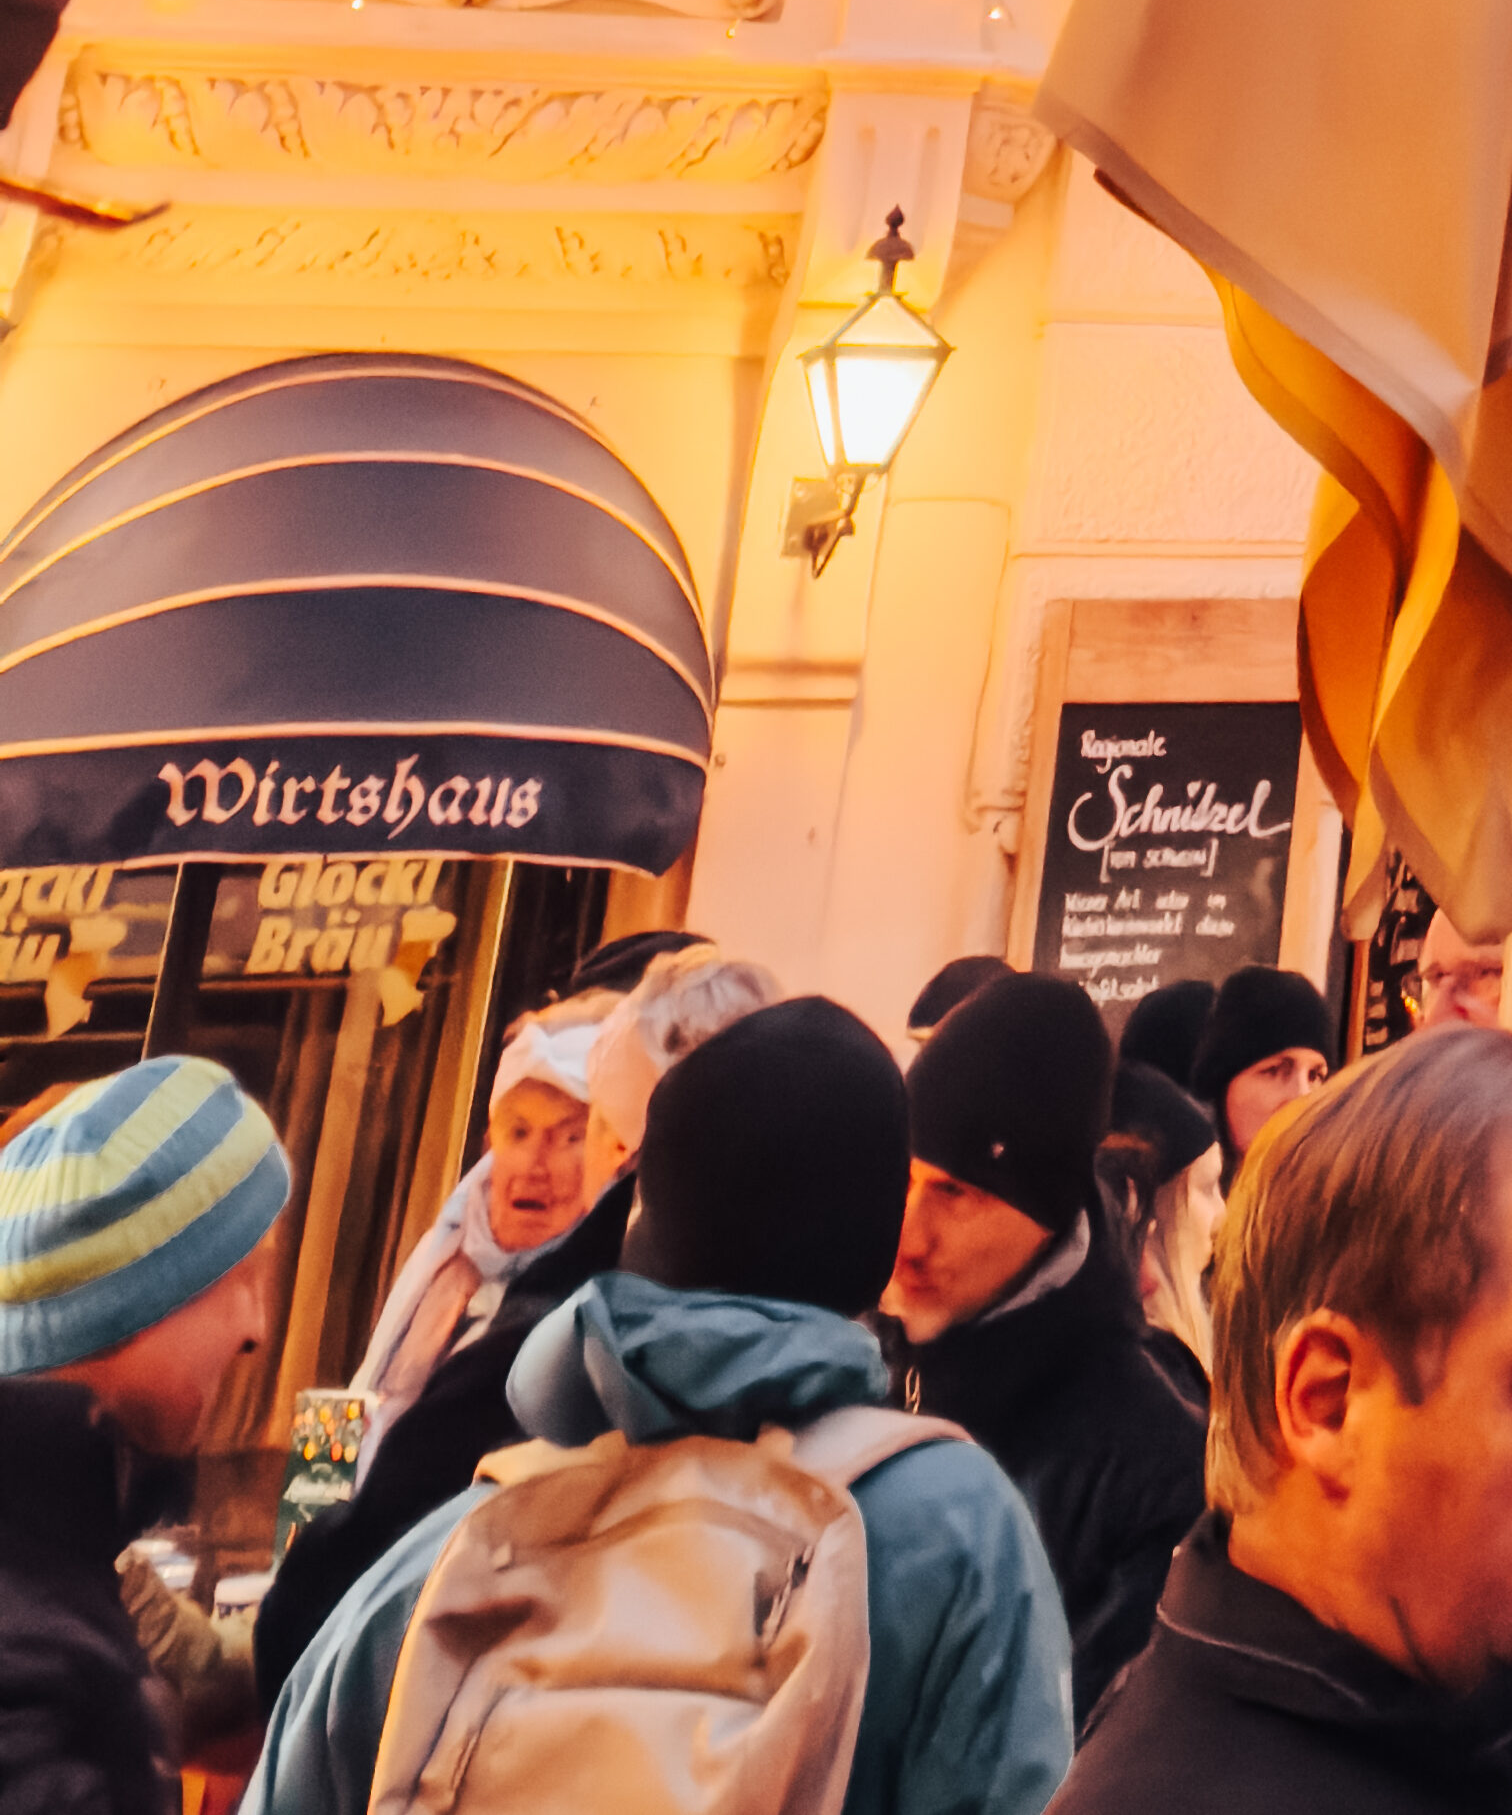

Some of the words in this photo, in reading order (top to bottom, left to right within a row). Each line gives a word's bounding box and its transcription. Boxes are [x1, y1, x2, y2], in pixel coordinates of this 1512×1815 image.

[158, 753, 543, 840] Wirtshaus
[1067, 764, 1293, 852] Schnitzel
[243, 907, 394, 975] Bräu
